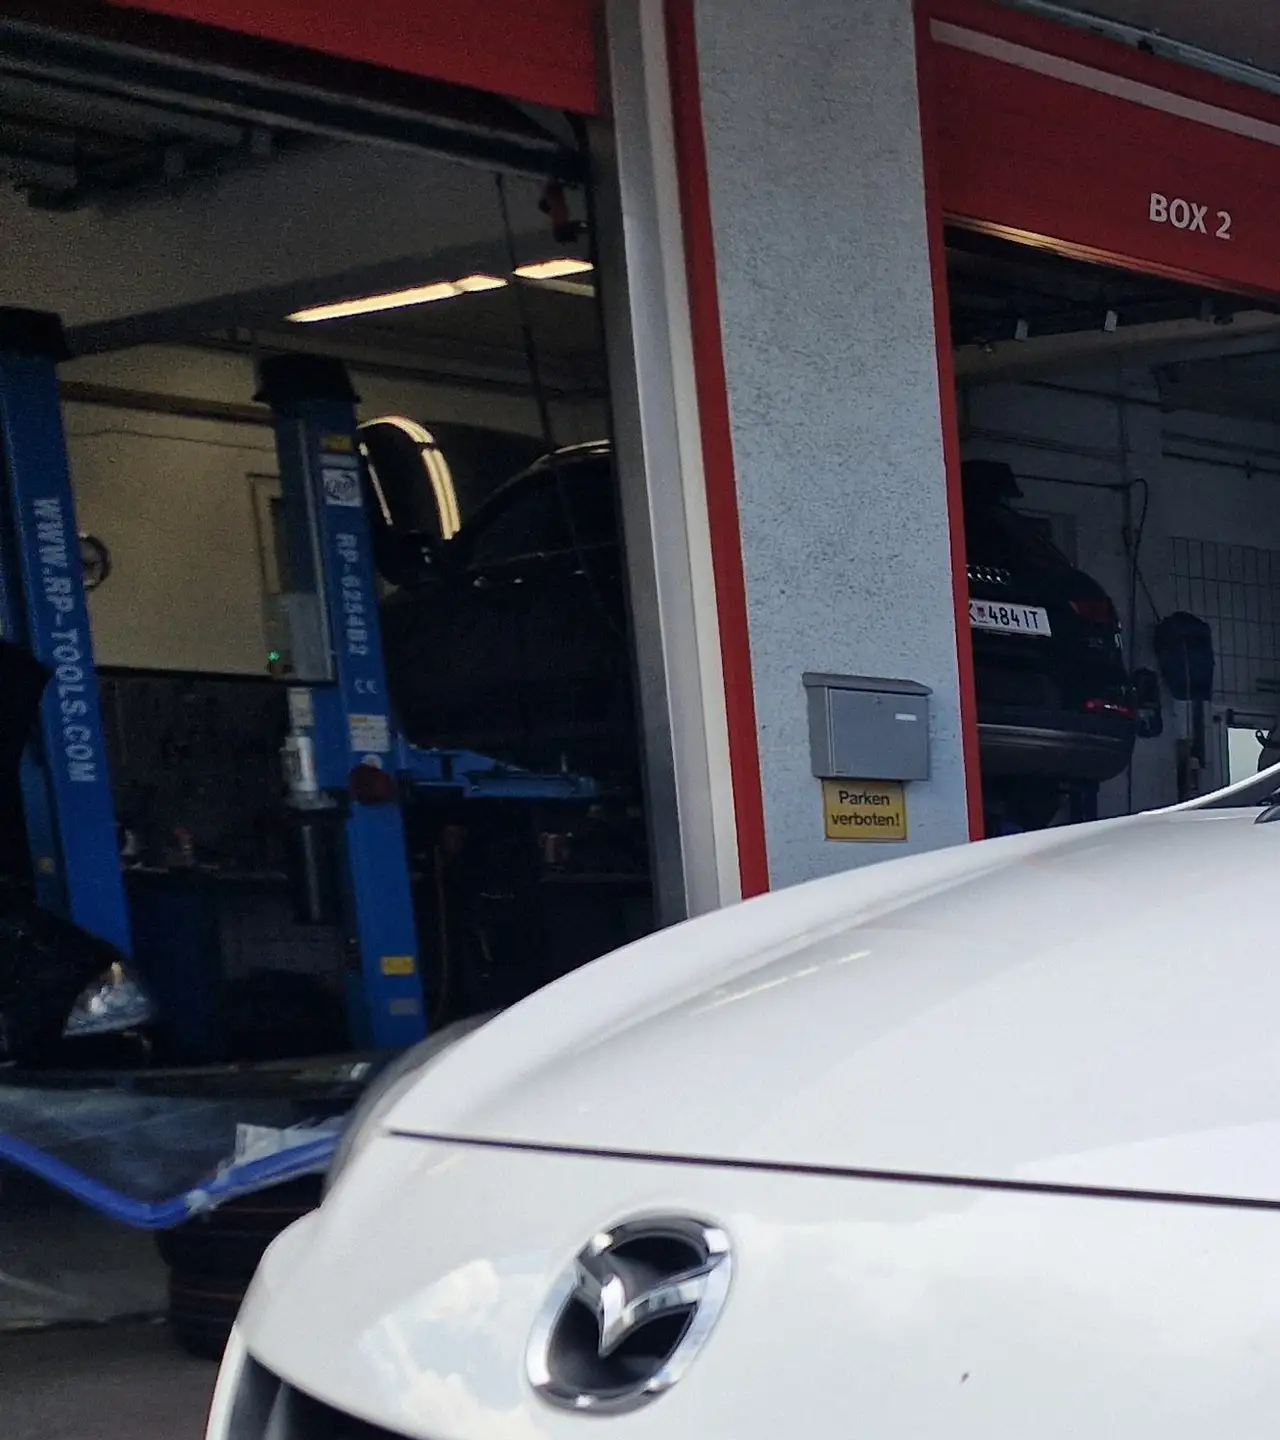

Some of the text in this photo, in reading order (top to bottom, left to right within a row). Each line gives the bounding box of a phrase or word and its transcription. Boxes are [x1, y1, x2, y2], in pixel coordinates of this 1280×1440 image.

[1149, 192, 1232, 240] BOX 2
[839, 790, 890, 806] Parken
[831, 812, 900, 828] verboten!
